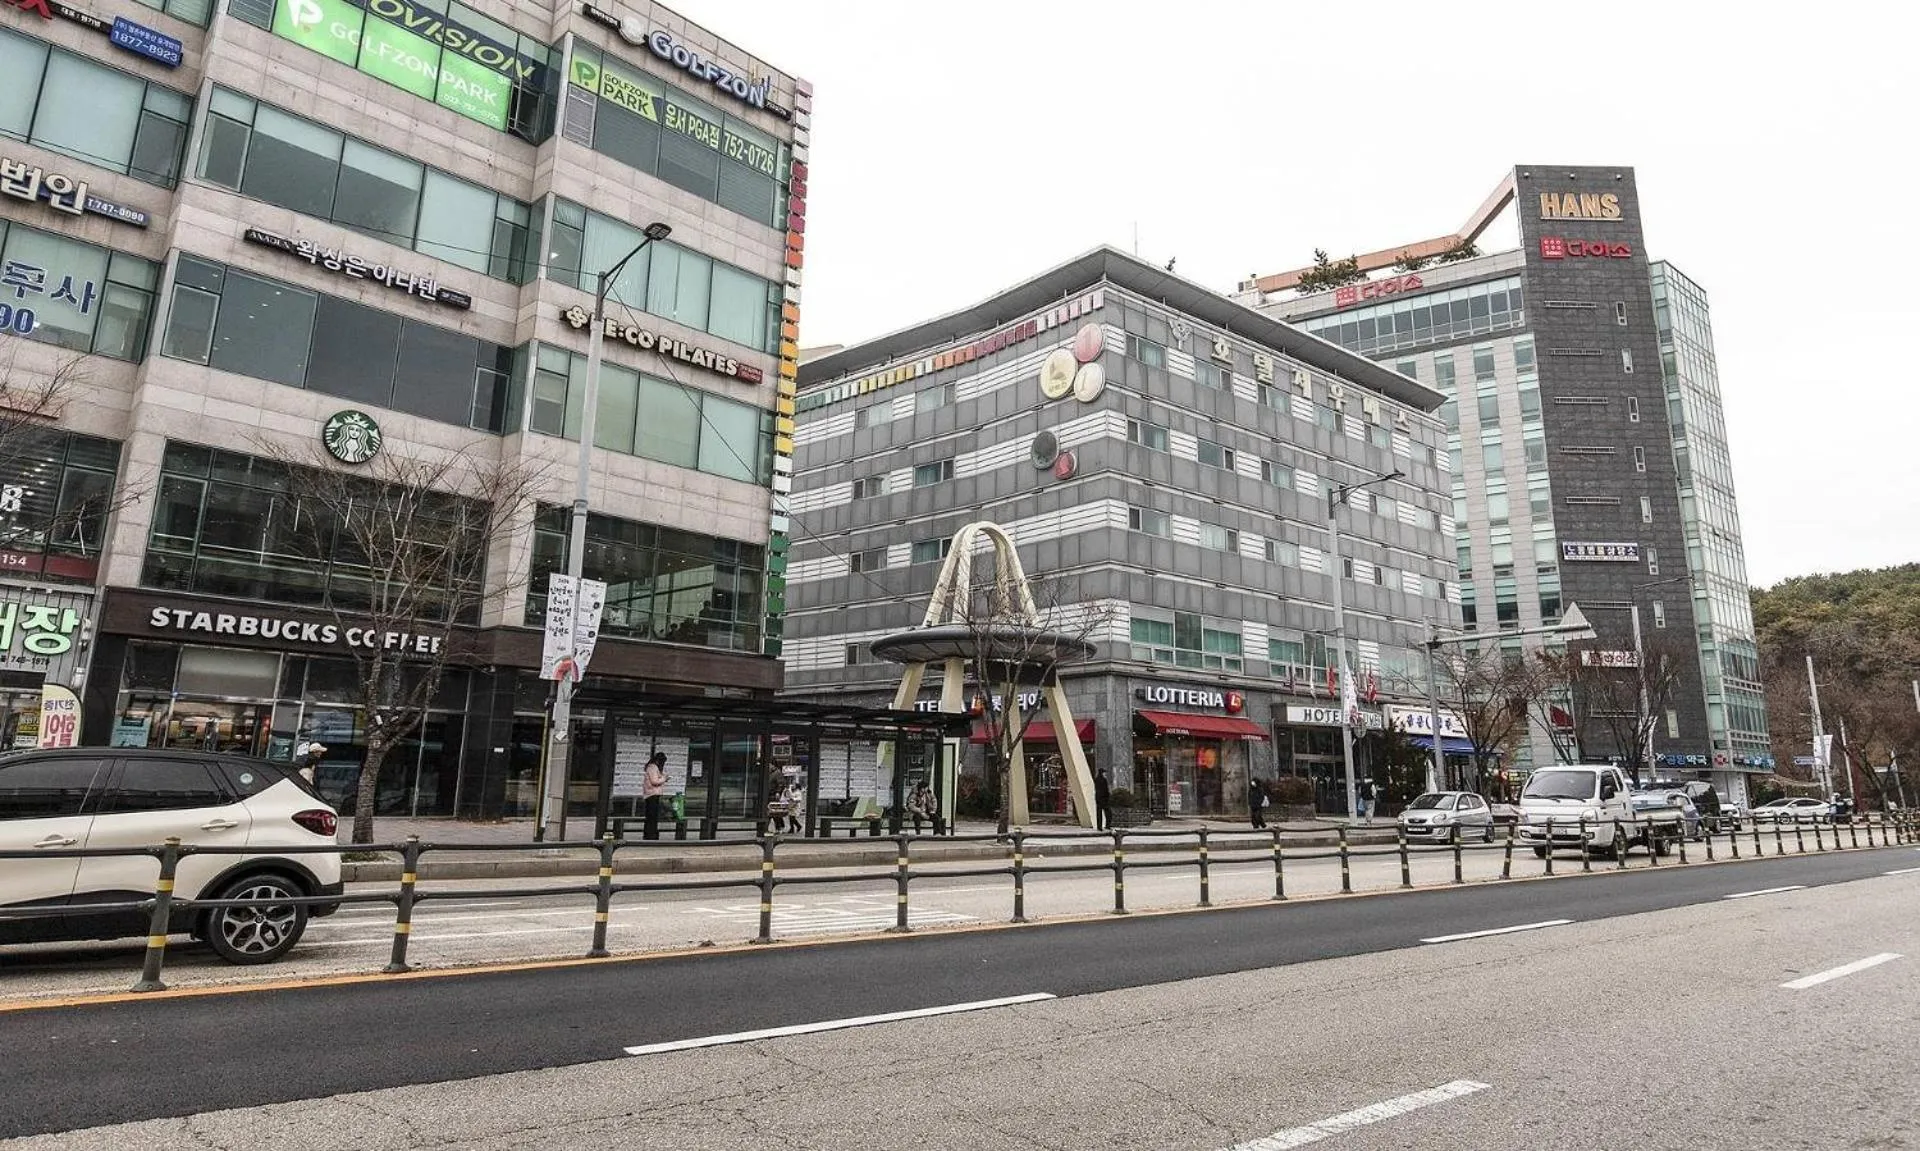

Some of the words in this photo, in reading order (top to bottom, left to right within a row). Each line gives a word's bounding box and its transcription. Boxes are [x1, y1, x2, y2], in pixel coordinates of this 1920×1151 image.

[114, 30, 178, 62] 1877-8923
[330, 22, 438, 80] GOLFZON
[441, 69, 497, 107] PARK
[649, 30, 765, 108] GOLFZON
[603, 83, 648, 115] PARK
[604, 73, 649, 100] GOLFZON
[665, 102, 687, 134] 운서
[689, 117, 720, 148] PGA점
[723, 130, 775, 174] 752-0726
[0, 158, 88, 215] 법인
[1540, 193, 1620, 218] HANS
[296, 238, 367, 278] 왁싱은
[1567, 240, 1632, 257] 다이소
[1362, 274, 1423, 300] 다이소
[658, 334, 738, 377] PILATES
[2, 553, 27, 567] 154
[151, 606, 338, 644] STARBUCKS
[1146, 686, 1225, 708] LOTTERIA
[1303, 708, 1345, 724] HOTE
